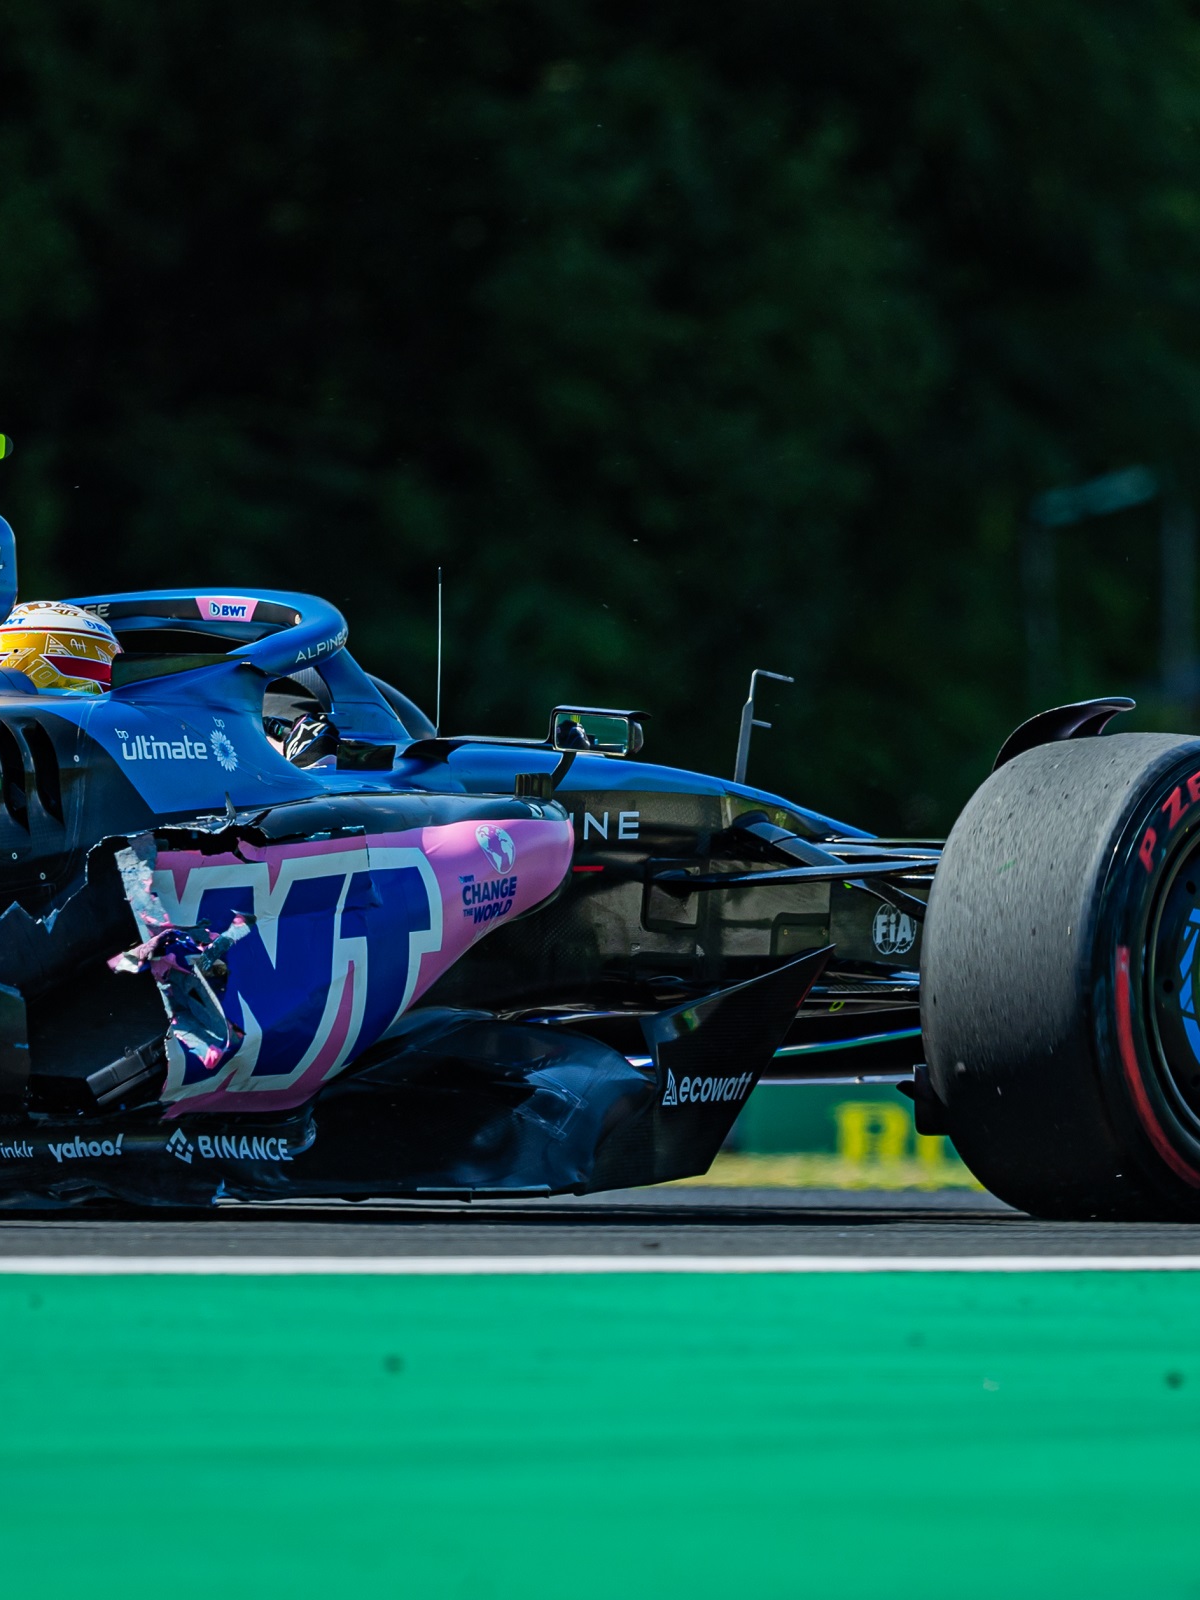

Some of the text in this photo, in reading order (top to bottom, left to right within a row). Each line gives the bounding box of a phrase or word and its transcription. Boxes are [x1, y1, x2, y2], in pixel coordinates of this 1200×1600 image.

[222, 605, 247, 617] BWT
[114, 728, 130, 741] bp
[212, 716, 225, 730] bp
[122, 734, 208, 760] ultimate
[462, 876, 518, 906] CHANGE
[463, 899, 513, 924] THE WORLD
[679, 1072, 753, 1103] ecowatt
[48, 1133, 124, 1163] yahoo!
[197, 1135, 294, 1161] BINANCE
